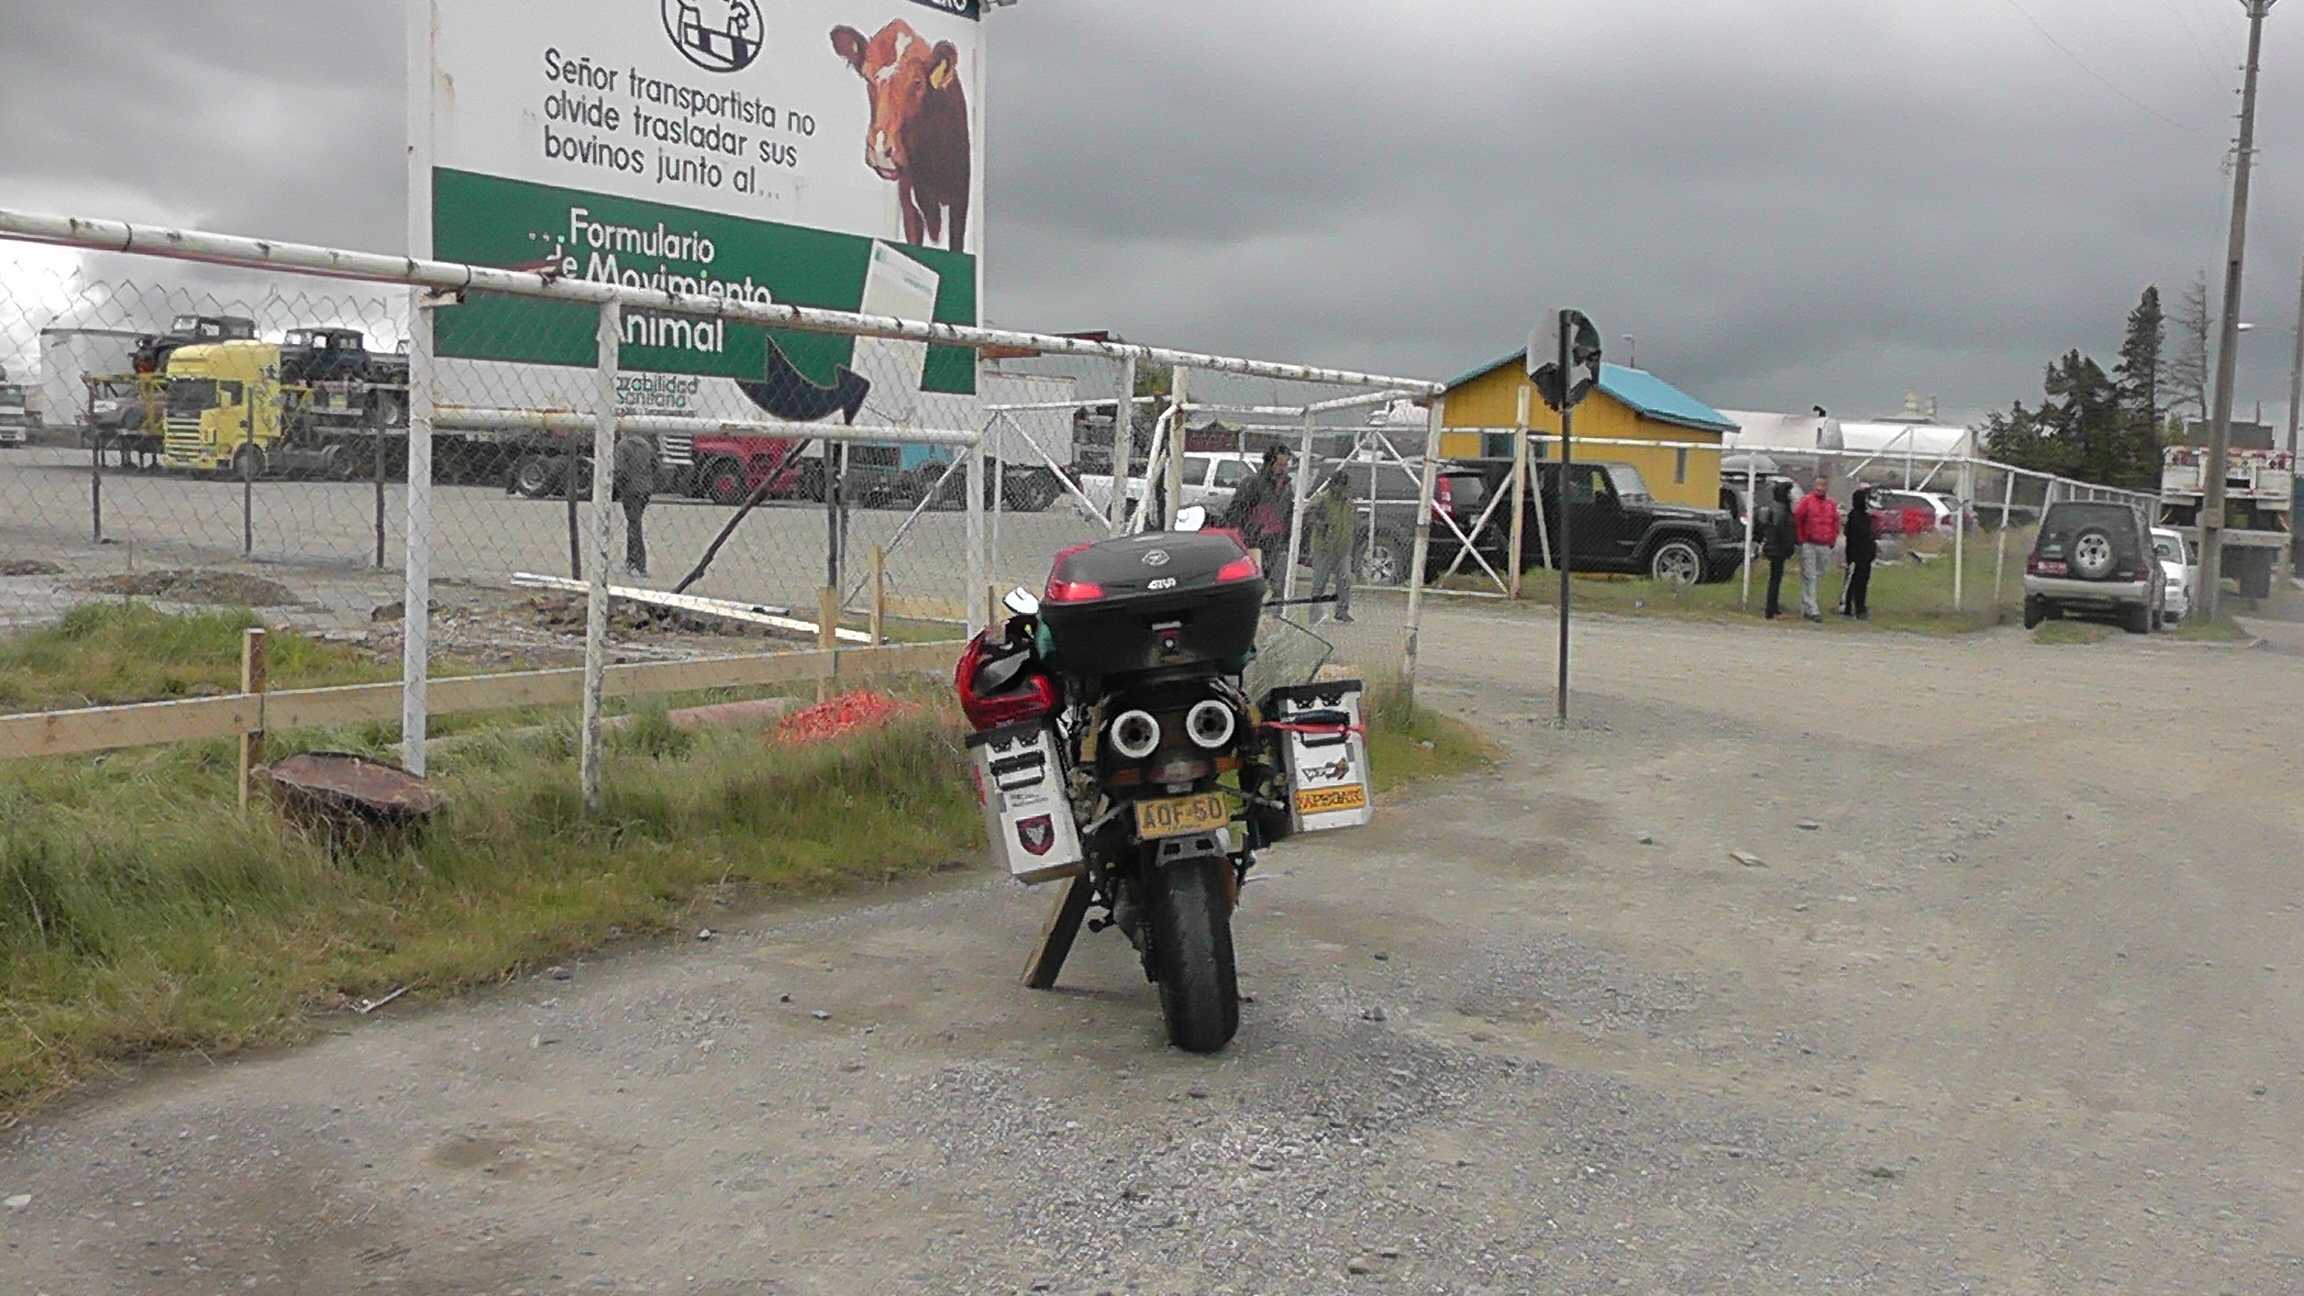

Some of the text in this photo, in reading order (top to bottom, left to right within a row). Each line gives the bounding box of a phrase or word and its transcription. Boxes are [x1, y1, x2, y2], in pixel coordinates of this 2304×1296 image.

[545, 47, 816, 136] Señor transportista no
[544, 89, 797, 168] olvide trasladar sus
[544, 124, 645, 174] bovinos
[656, 147, 722, 187] junto
[586, 251, 772, 305] Movimiento
[617, 313, 723, 353] nimal
